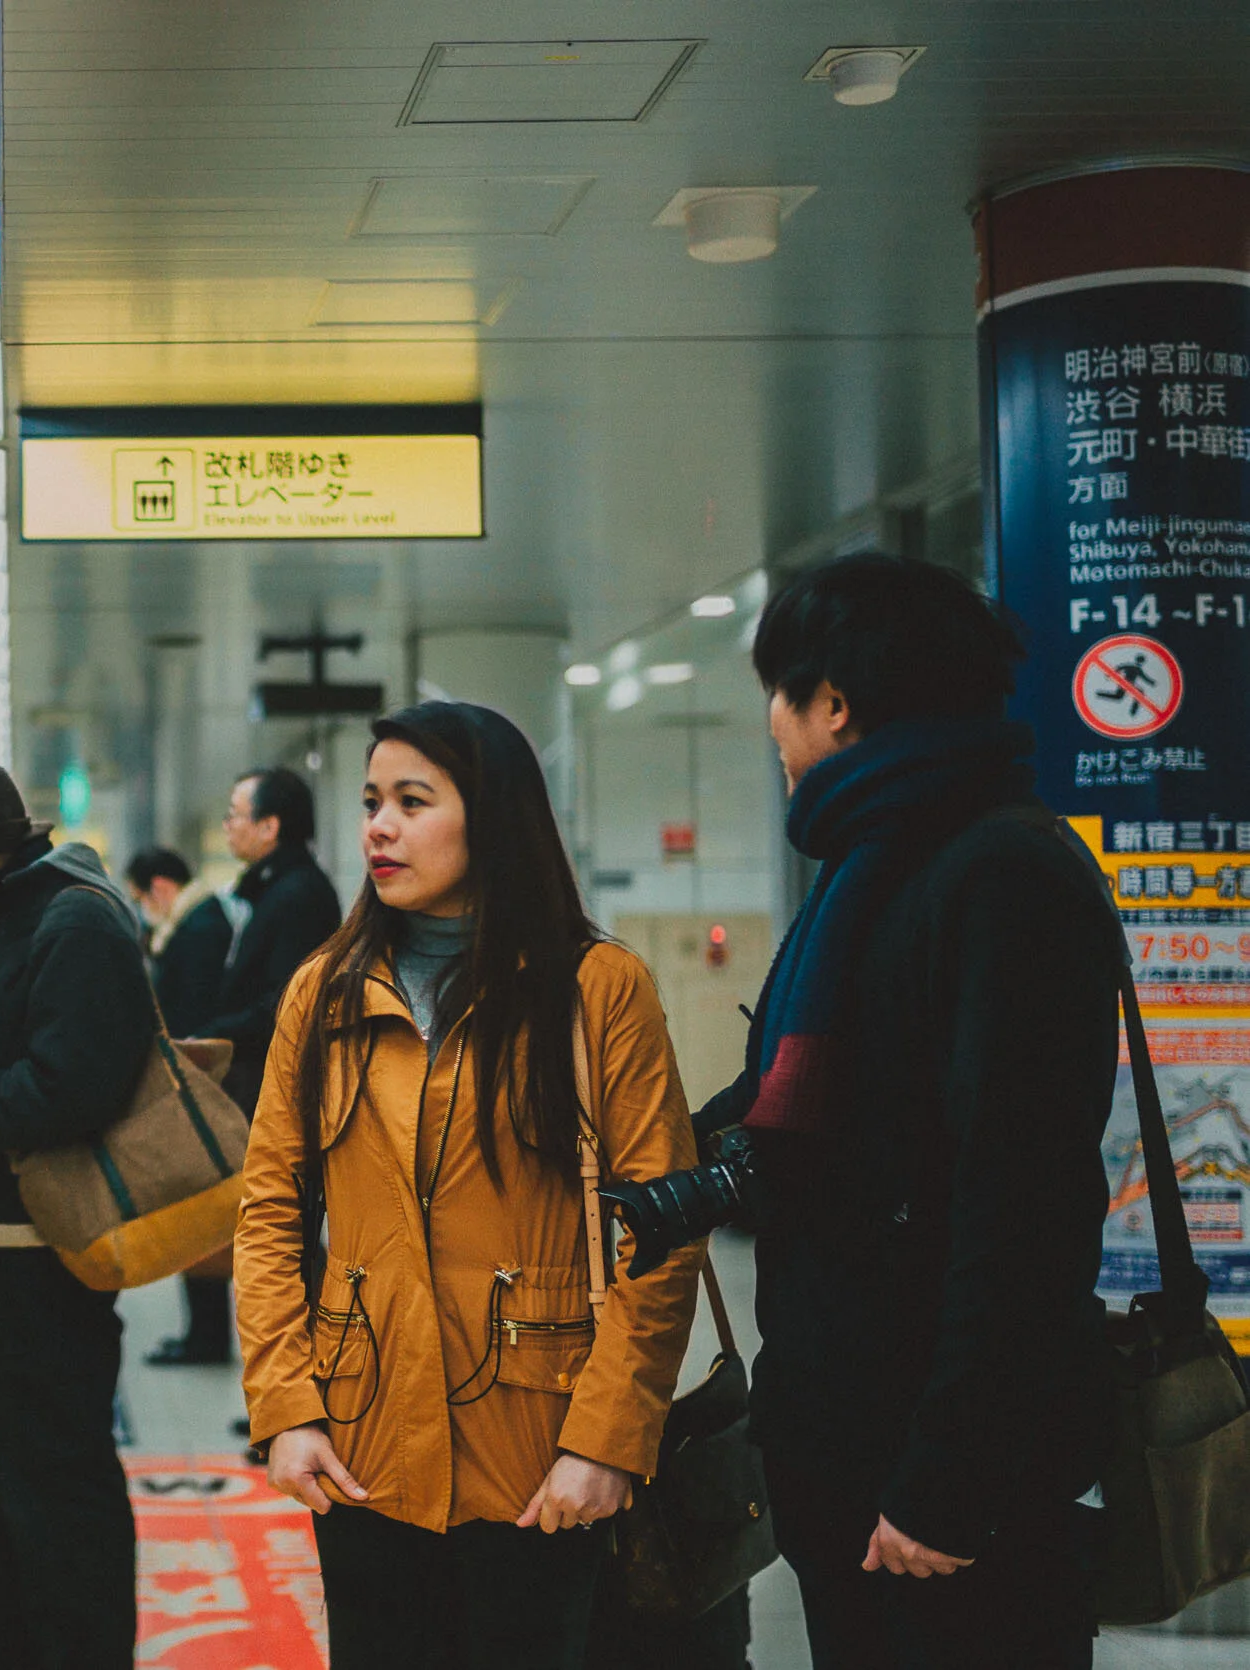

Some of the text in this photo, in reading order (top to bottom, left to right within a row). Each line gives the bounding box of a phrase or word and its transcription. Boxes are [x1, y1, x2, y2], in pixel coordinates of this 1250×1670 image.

[1066, 382, 1227, 425] 渋谷 横浜
[205, 451, 352, 479] 改札階ゆき
[204, 482, 374, 508] エレベーター
[1067, 471, 1129, 504] 方面
[204, 510, 396, 529] Elevator to Upper Level
[1069, 521, 1100, 541] for
[1069, 541, 1158, 563] Shibuya,
[1076, 747, 1207, 774] かけこみ禁止
